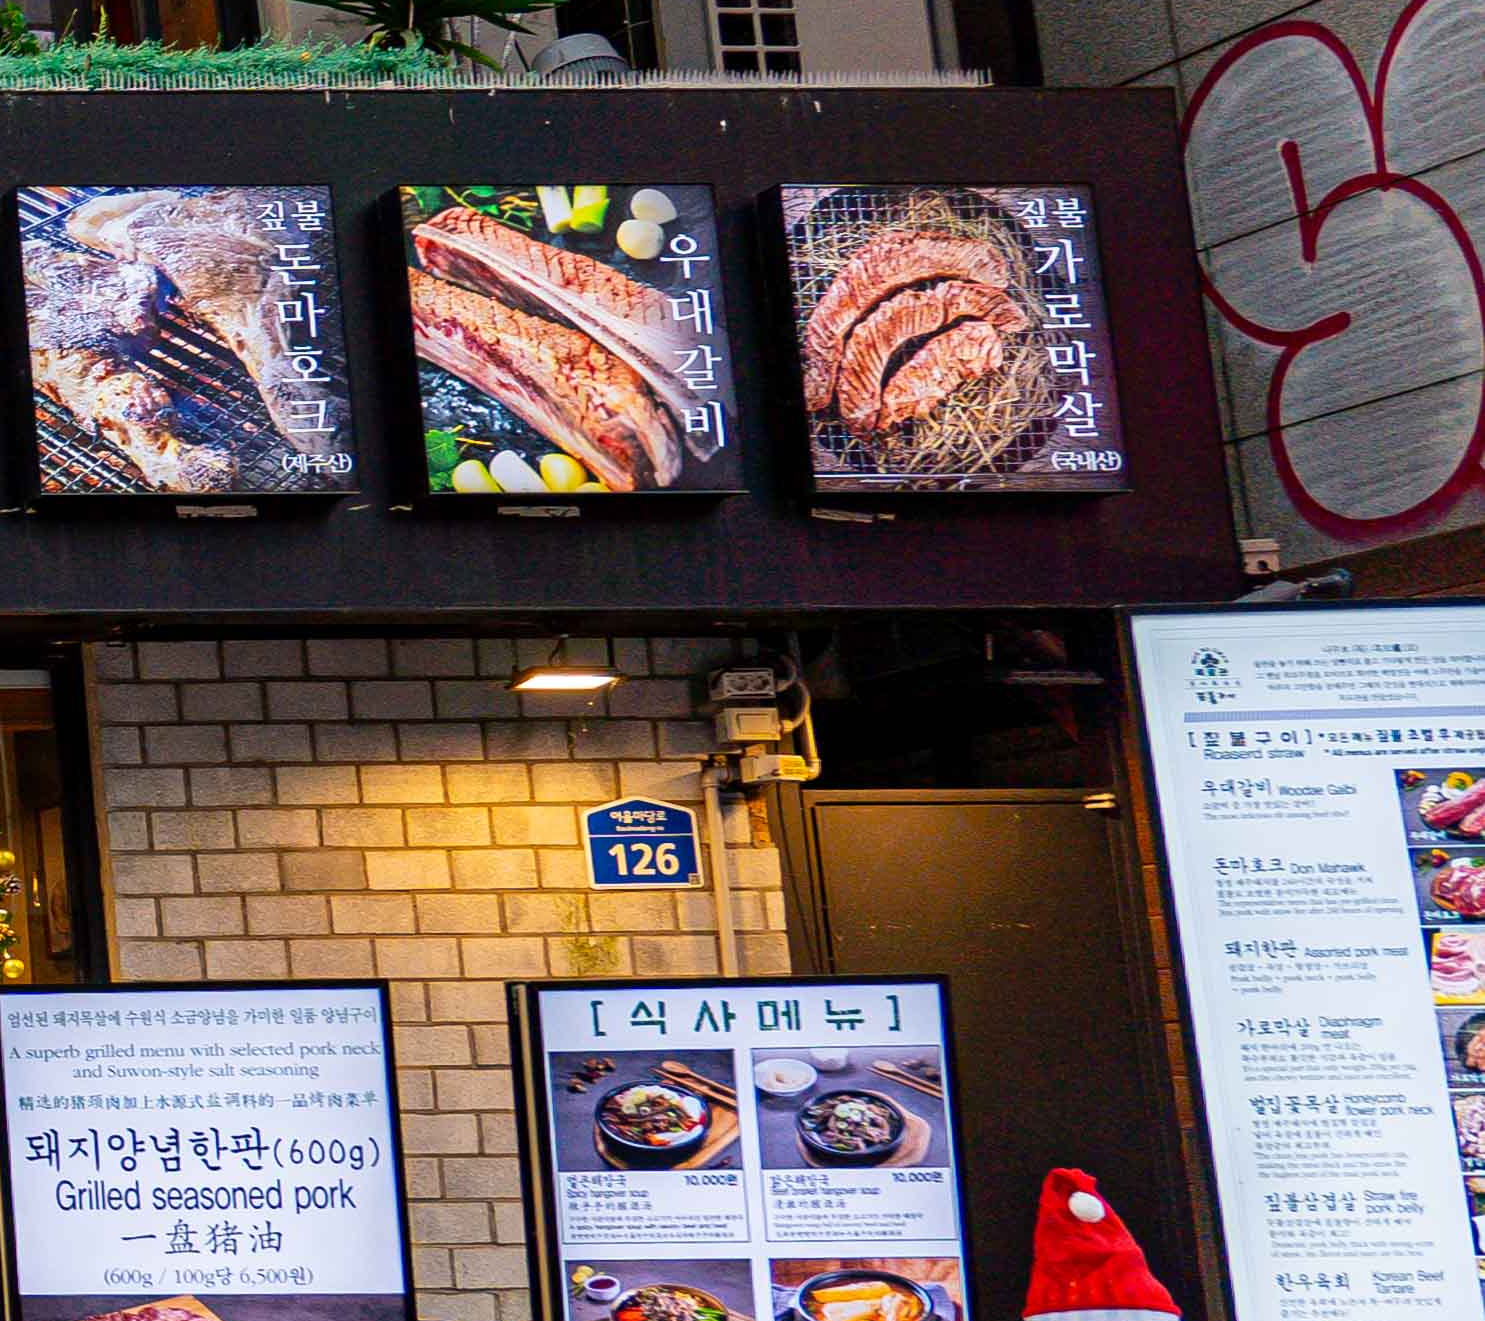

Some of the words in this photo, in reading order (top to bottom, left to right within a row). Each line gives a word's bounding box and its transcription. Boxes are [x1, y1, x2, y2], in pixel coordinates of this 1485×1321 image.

[254, 200, 328, 235] 짚불
[1014, 196, 1088, 231] 짚불
[269, 243, 338, 436] 돈마호크
[659, 235, 728, 450] 우대갈비
[1033, 239, 1104, 440] 가로막살
[281, 451, 354, 476] (제주산)
[1050, 449, 1123, 474] (국내산)
[608, 842, 680, 876] 126
[24, 1125, 381, 1174] 돼지양념한판(600g)
[54, 1178, 142, 1212] Grilled
[151, 1178, 283, 1211] seasoned
[294, 1177, 358, 1215] pork
